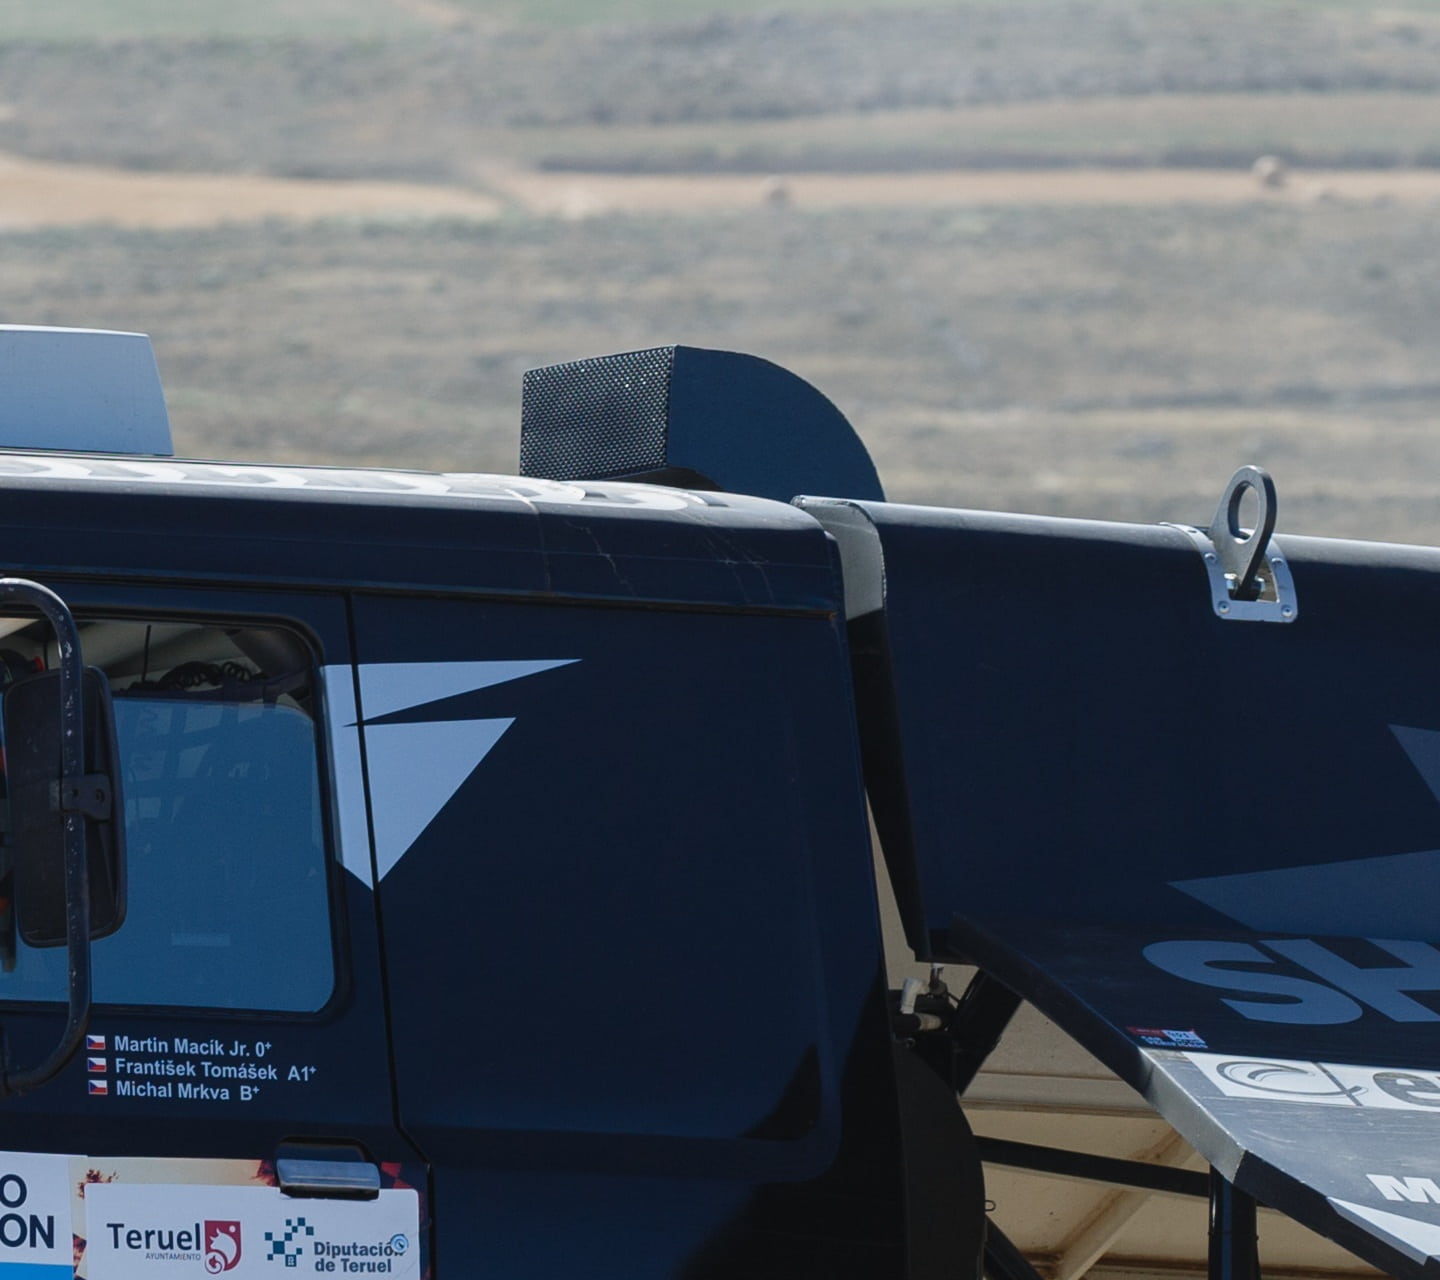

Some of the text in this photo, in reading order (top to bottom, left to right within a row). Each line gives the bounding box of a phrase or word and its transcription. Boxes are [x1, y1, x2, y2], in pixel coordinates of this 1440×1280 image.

[114, 1035, 168, 1053] Martin
[174, 1037, 225, 1057] Macík
[229, 1040, 251, 1058] Jr.
[115, 1058, 196, 1078] František
[201, 1061, 278, 1081] Tomášek
[116, 1080, 172, 1099] Michal
[178, 1083, 230, 1101] Mrkva
[106, 1221, 202, 1251] Teruel
[145, 1252, 202, 1262] AYUNTAMIENTO
[314, 1258, 393, 1274] de Teruel
